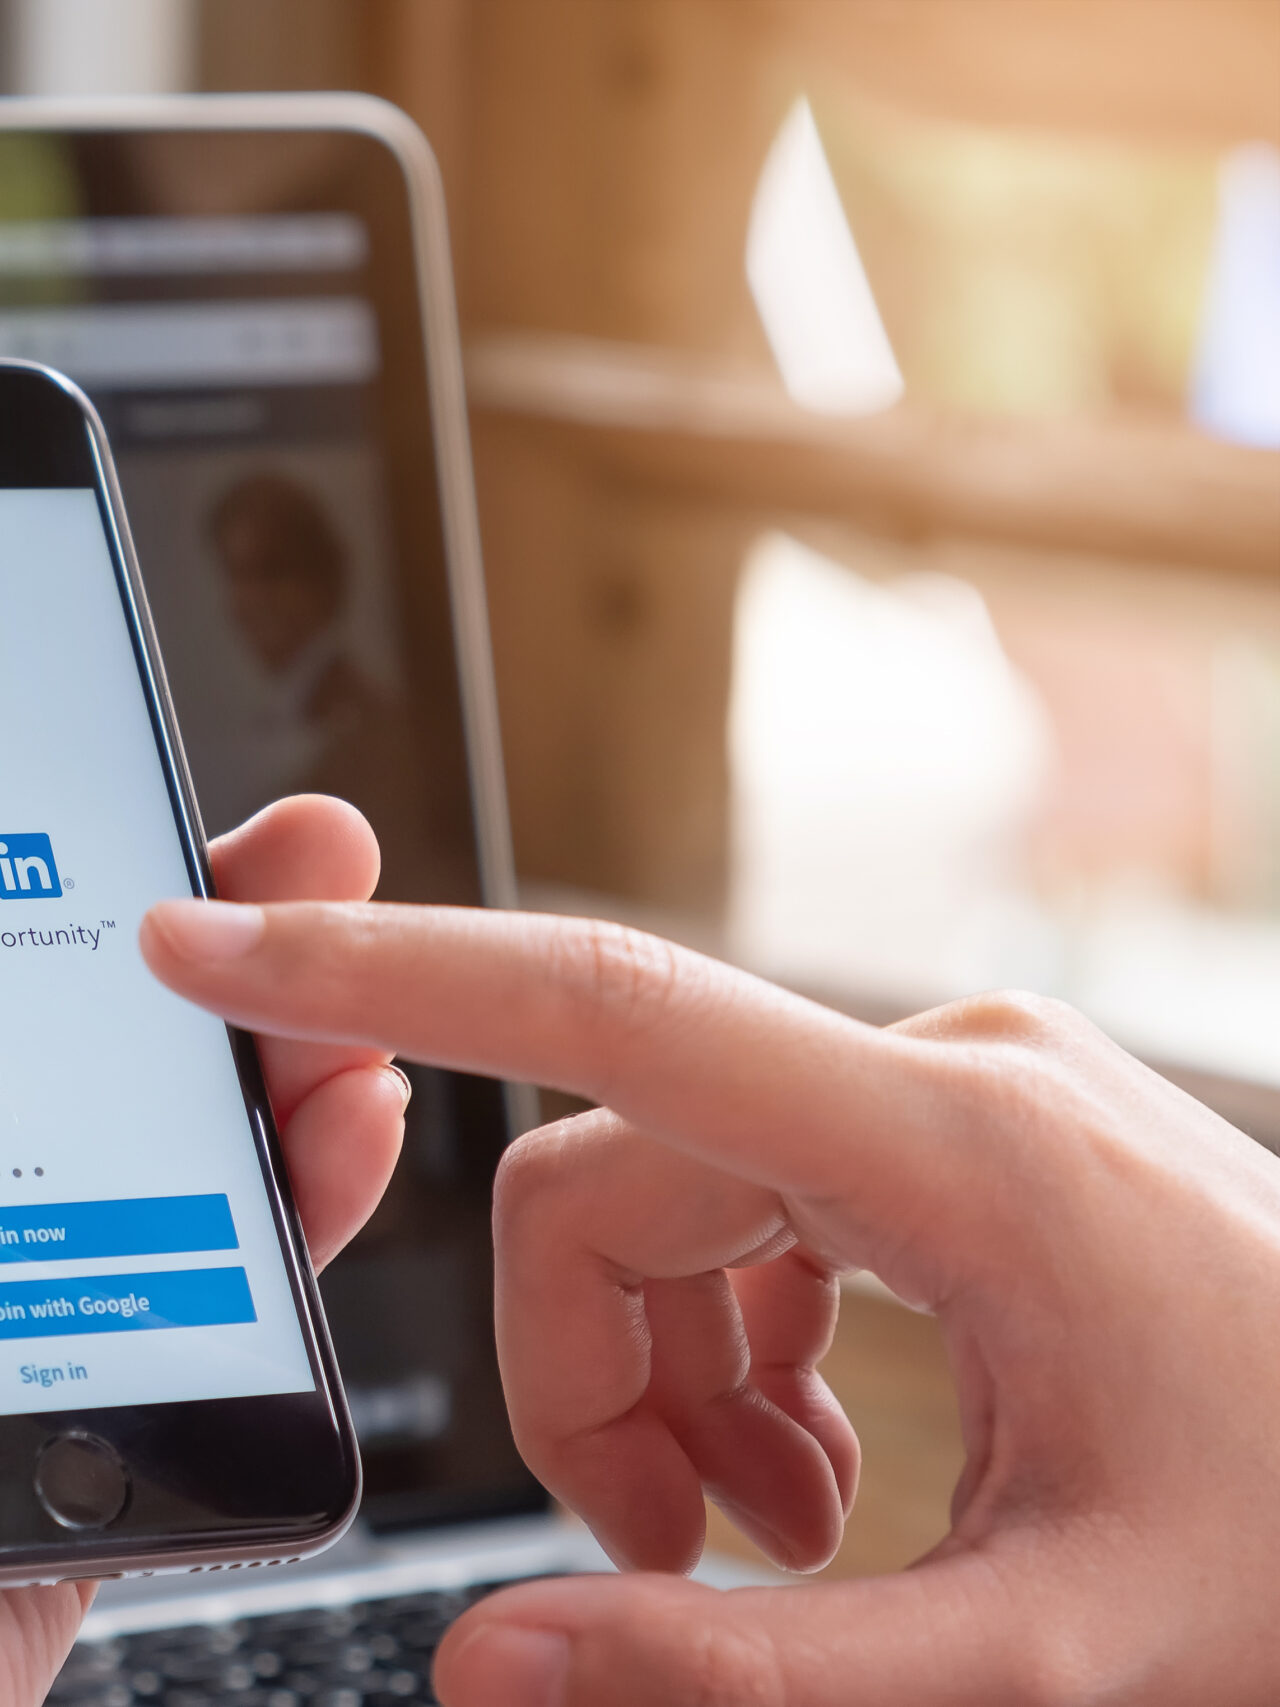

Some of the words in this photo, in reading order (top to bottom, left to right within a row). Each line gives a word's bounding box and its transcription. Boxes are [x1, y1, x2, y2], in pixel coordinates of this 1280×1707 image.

[23, 1227, 66, 1244] now
[28, 1297, 75, 1318] with
[78, 1293, 150, 1319] Google
[19, 1364, 64, 1388] Sign
[67, 1362, 88, 1381] in
